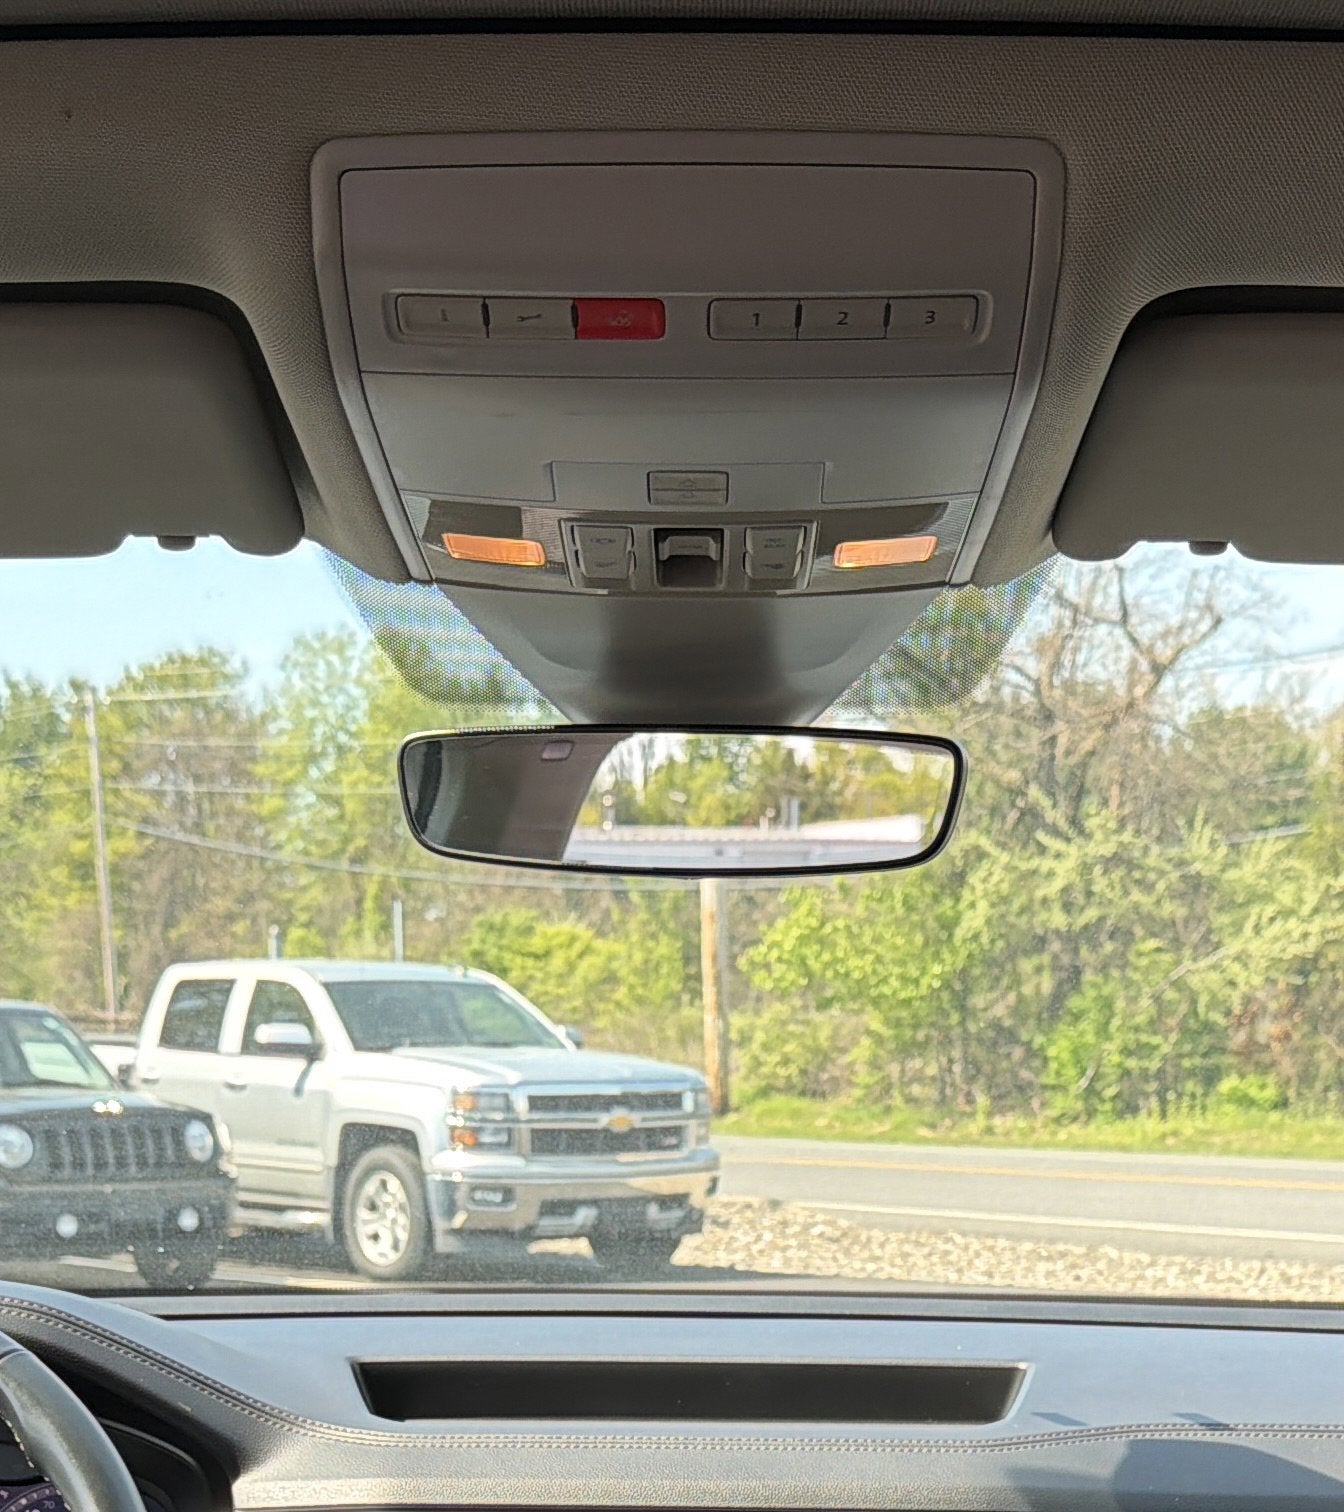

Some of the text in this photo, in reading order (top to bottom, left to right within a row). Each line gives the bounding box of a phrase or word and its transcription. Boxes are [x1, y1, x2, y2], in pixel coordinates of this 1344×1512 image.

[753, 313, 760, 326] 1
[837, 312, 848, 325] 2
[925, 311, 935, 324] 3
